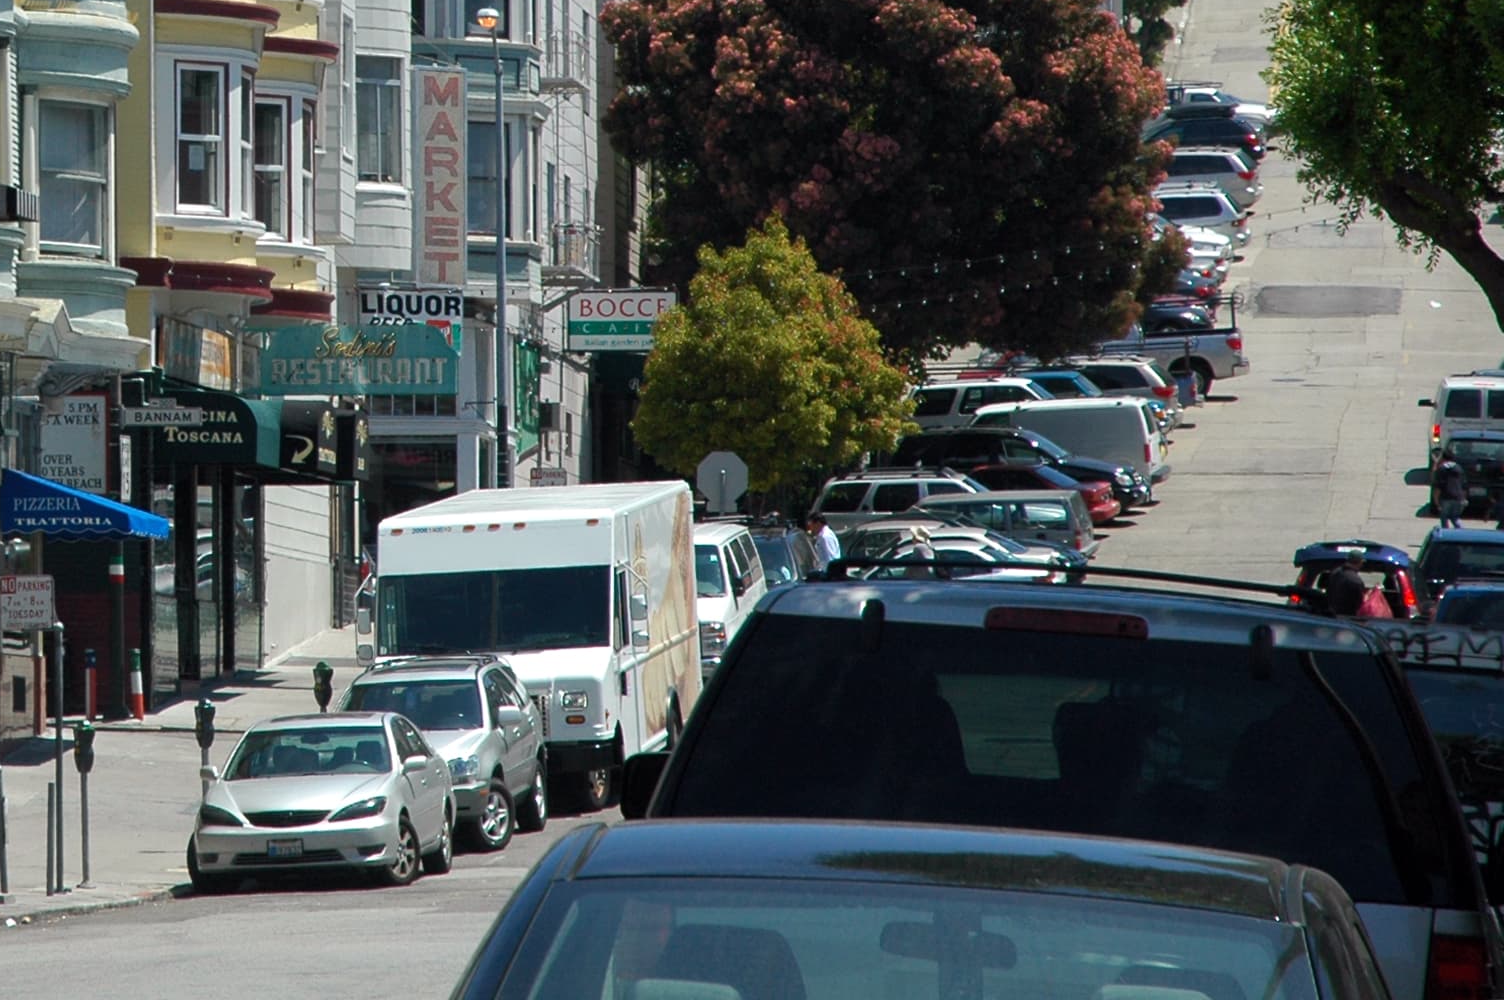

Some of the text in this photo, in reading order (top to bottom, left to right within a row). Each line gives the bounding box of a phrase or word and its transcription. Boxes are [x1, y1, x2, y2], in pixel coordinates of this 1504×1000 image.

[423, 74, 460, 283] MARKET
[361, 293, 462, 318] LIQUOR
[271, 357, 448, 385] RESTAURANT
[63, 415, 100, 425] WEEK
[133, 411, 193, 423] BANNAM
[43, 454, 73, 465] OVER
[52, 466, 85, 477] YEARS
[66, 478, 103, 489] BEACH
[13, 497, 81, 511] PIZZERIA
[14, 517, 112, 526] TRATTORIA
[0, 578, 50, 594] NO PARKING
[8, 609, 44, 619] TUESDAY
